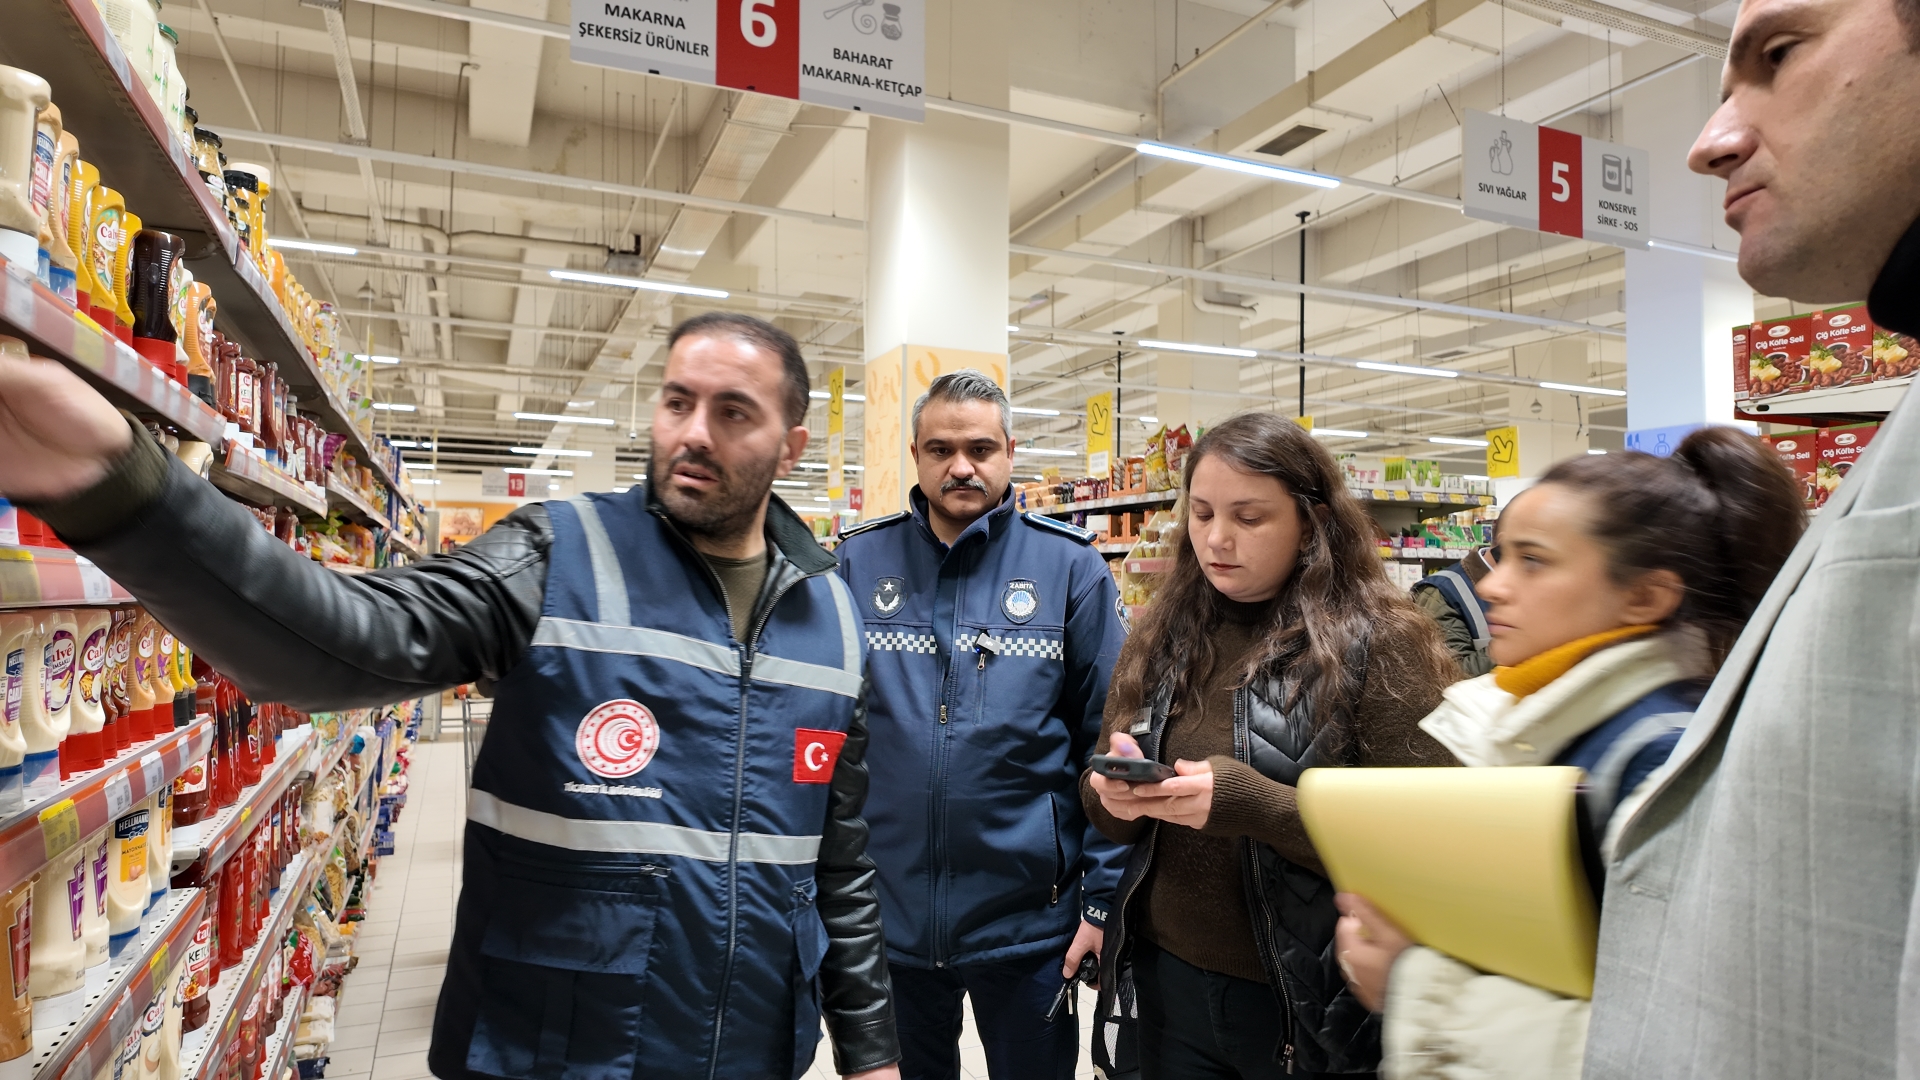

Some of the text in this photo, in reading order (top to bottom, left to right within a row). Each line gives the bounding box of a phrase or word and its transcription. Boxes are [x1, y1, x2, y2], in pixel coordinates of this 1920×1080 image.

[604, 2, 686, 31] MAKARNA
[739, 0, 778, 48] 6
[578, 21, 710, 57] ŞEKERSİZ ÜRÜNLER
[832, 47, 894, 71] BAHARAT
[801, 63, 923, 99] MAKARNA-KETÇAP
[1551, 161, 1571, 203] 5
[1478, 182, 1527, 201] SIVI YAĞLAR
[1598, 199, 1637, 216] KONSERVE
[1597, 214, 1618, 228] SİRKE
[1623, 220, 1639, 232] SOS
[1816, 323, 1866, 340] Çiğ Köfte Seti
[1755, 341, 1768, 350] Çiğ
[1769, 338, 1789, 347] Köfte
[1789, 335, 1805, 344] Seti
[1796, 452, 1810, 460] Seti
[1822, 449, 1835, 458] Çiğ
[1835, 446, 1856, 455] Köfte
[510, 478, 524, 492] 13
[851, 494, 862, 504] 14
